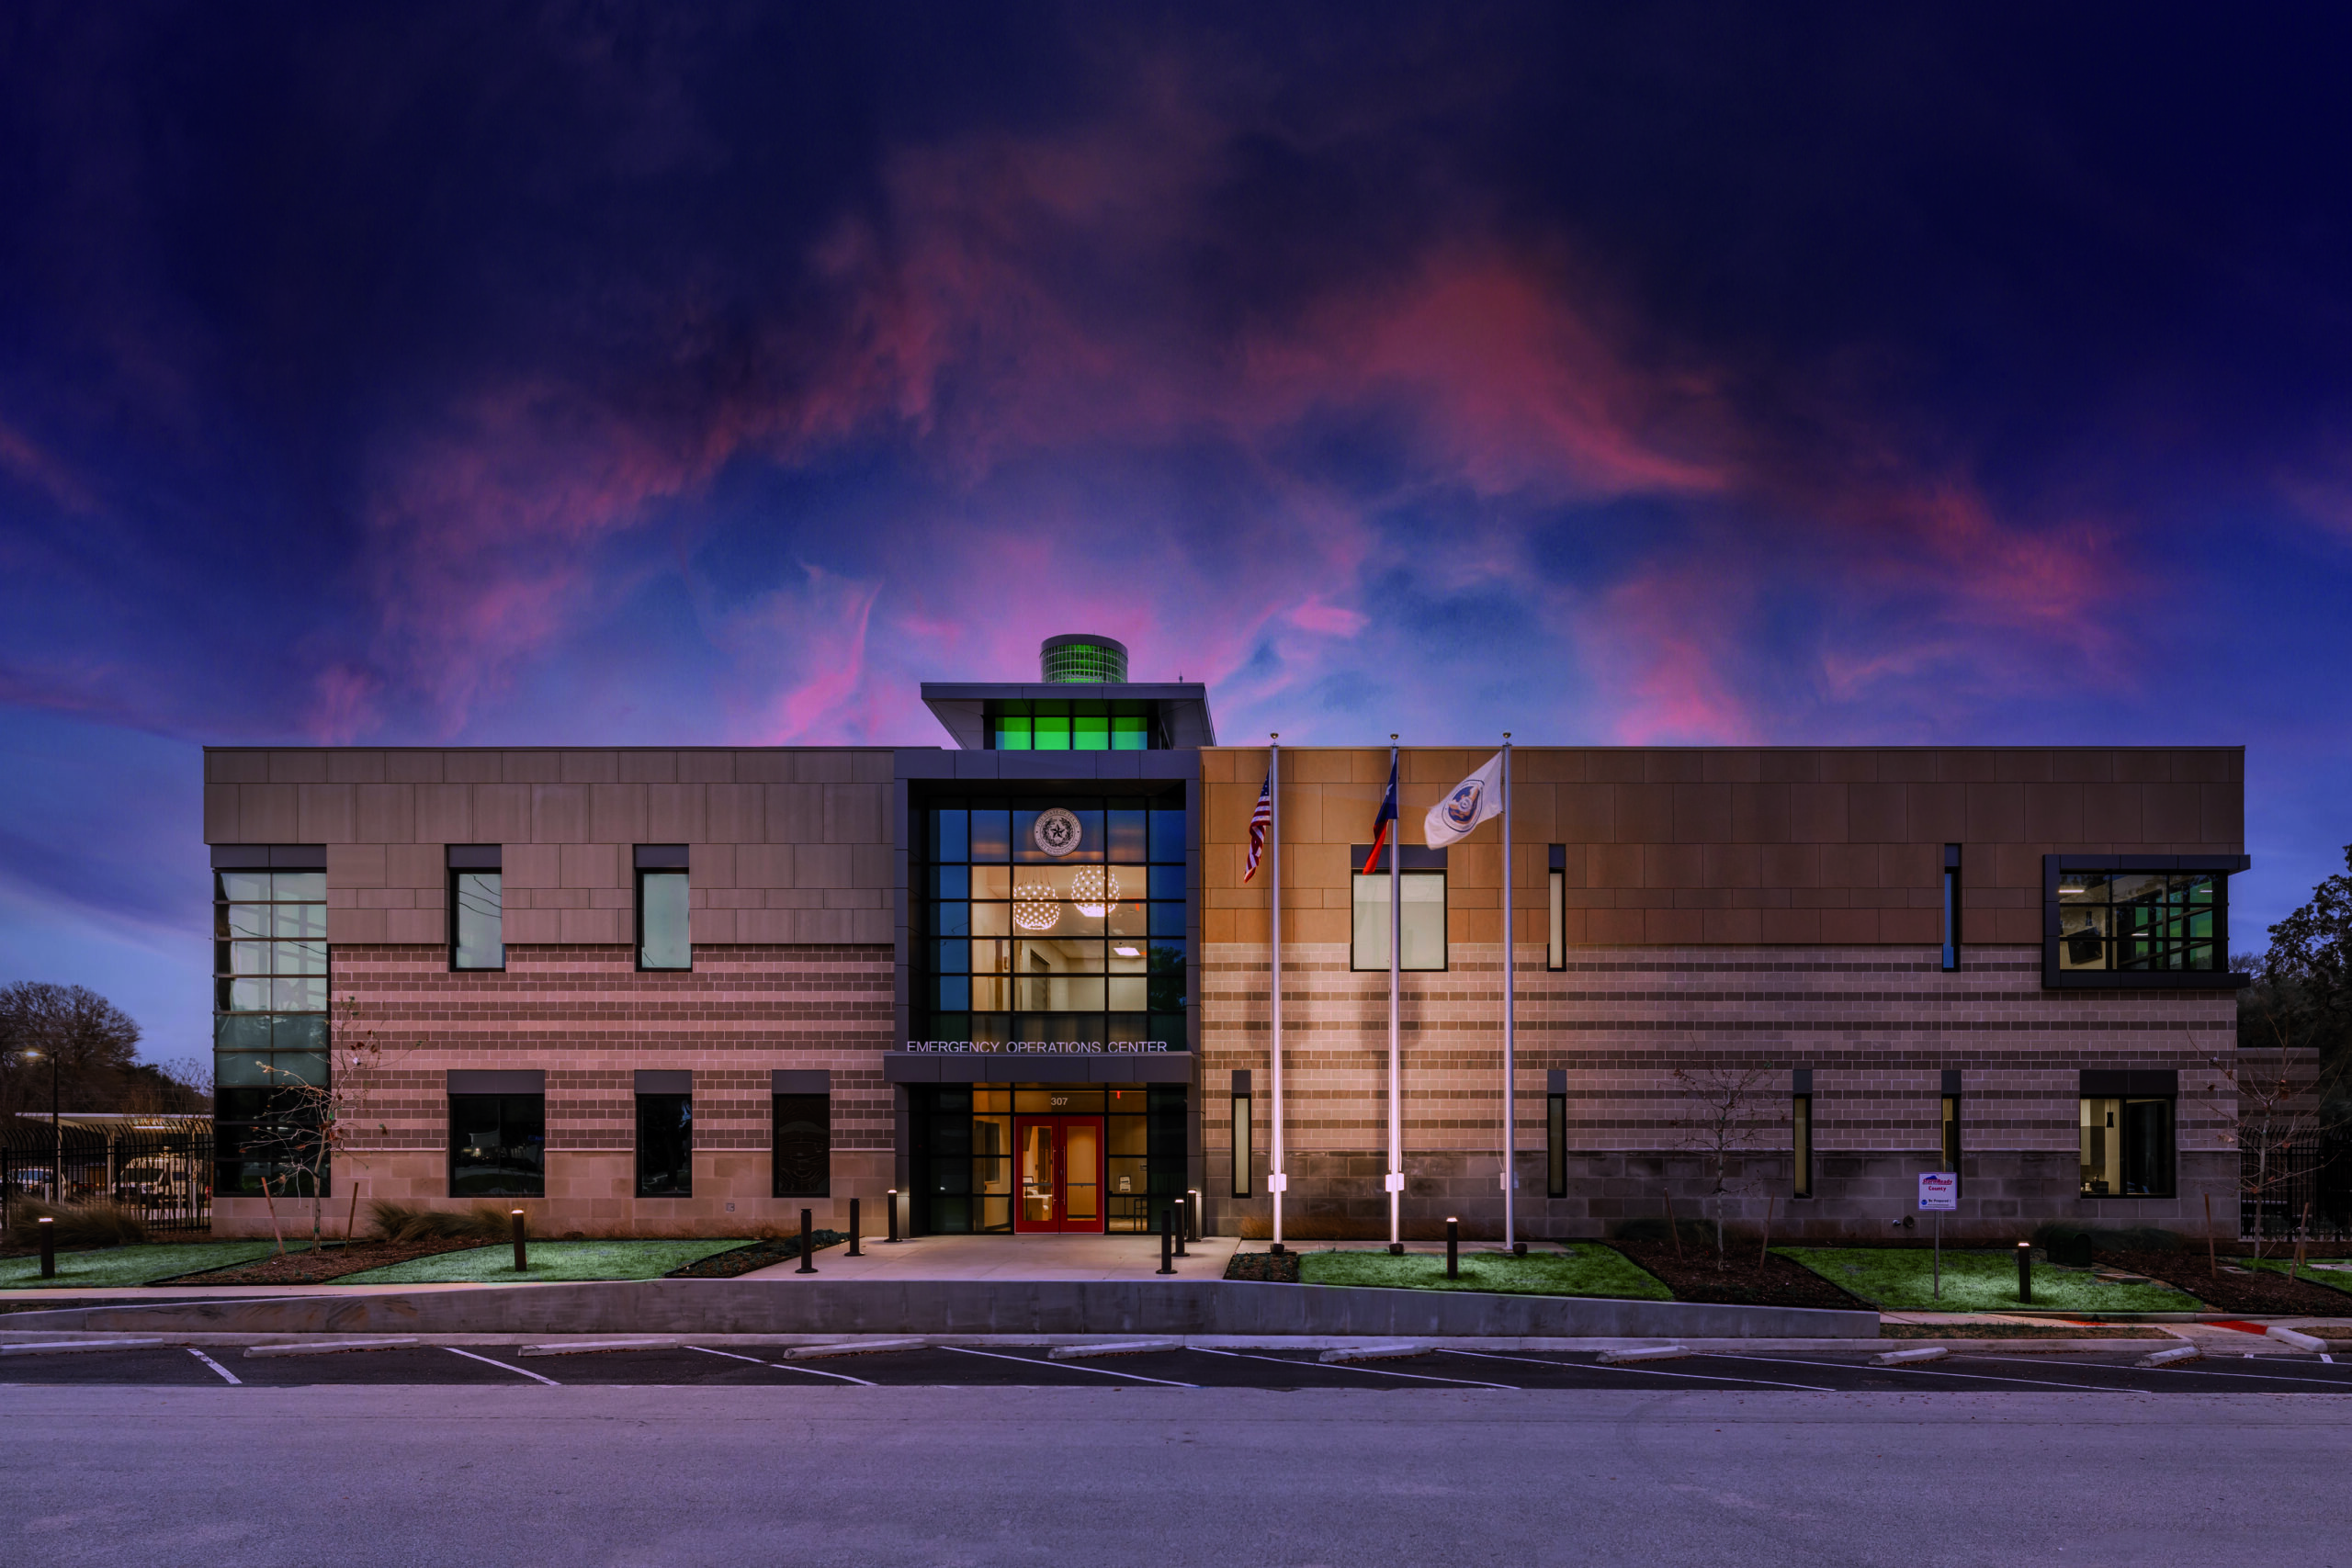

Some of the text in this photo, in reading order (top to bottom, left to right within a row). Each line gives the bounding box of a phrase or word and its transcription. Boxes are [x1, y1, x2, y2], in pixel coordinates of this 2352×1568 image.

[907, 1041, 1168, 1054] EMERGENCY OPERATIONS CENTER
[1050, 1097, 1069, 1106] 307
